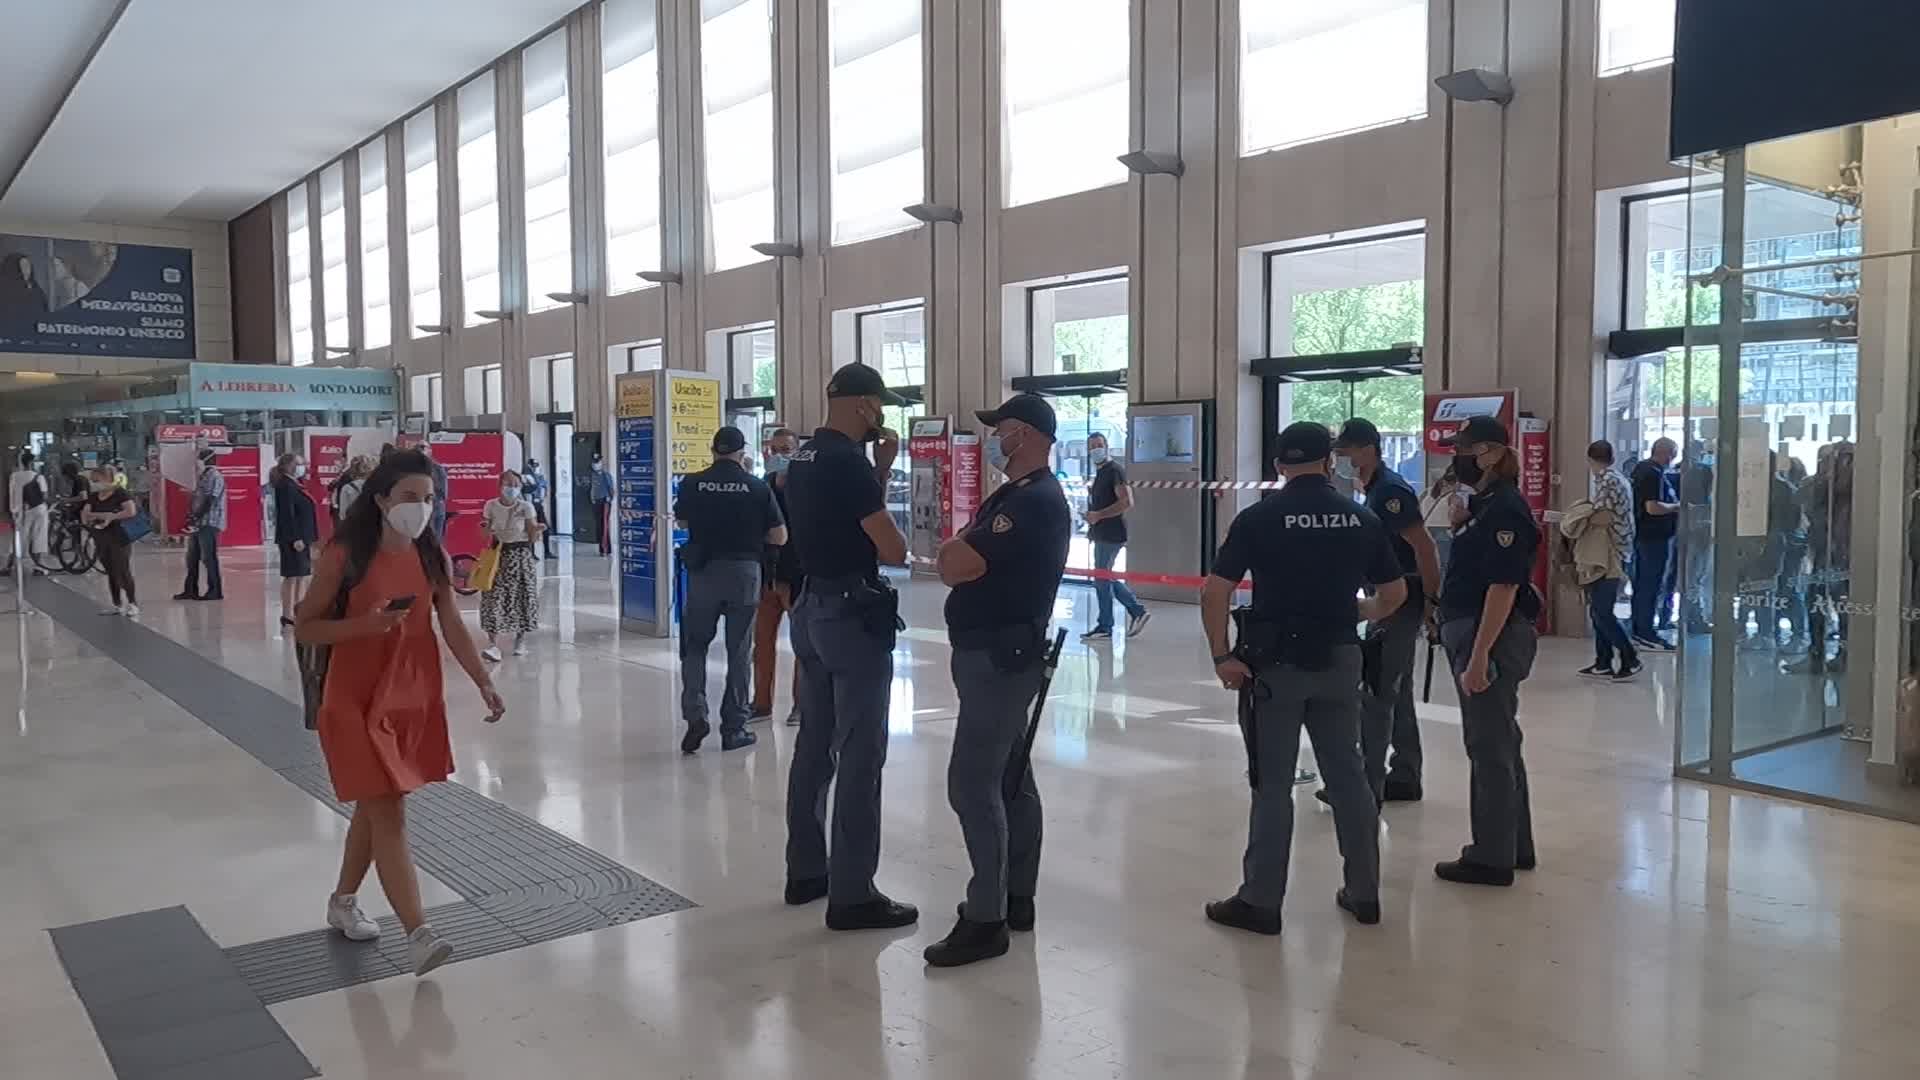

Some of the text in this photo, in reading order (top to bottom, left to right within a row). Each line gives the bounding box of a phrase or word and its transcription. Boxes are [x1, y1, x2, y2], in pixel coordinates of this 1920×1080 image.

[131, 291, 184, 303] PADOVA
[141, 317, 184, 328] SIAMO
[37, 323, 185, 339] PATRIMONIO UNESCO
[698, 482, 750, 493] POLIZIA
[1284, 513, 1361, 528] POLIZIA
